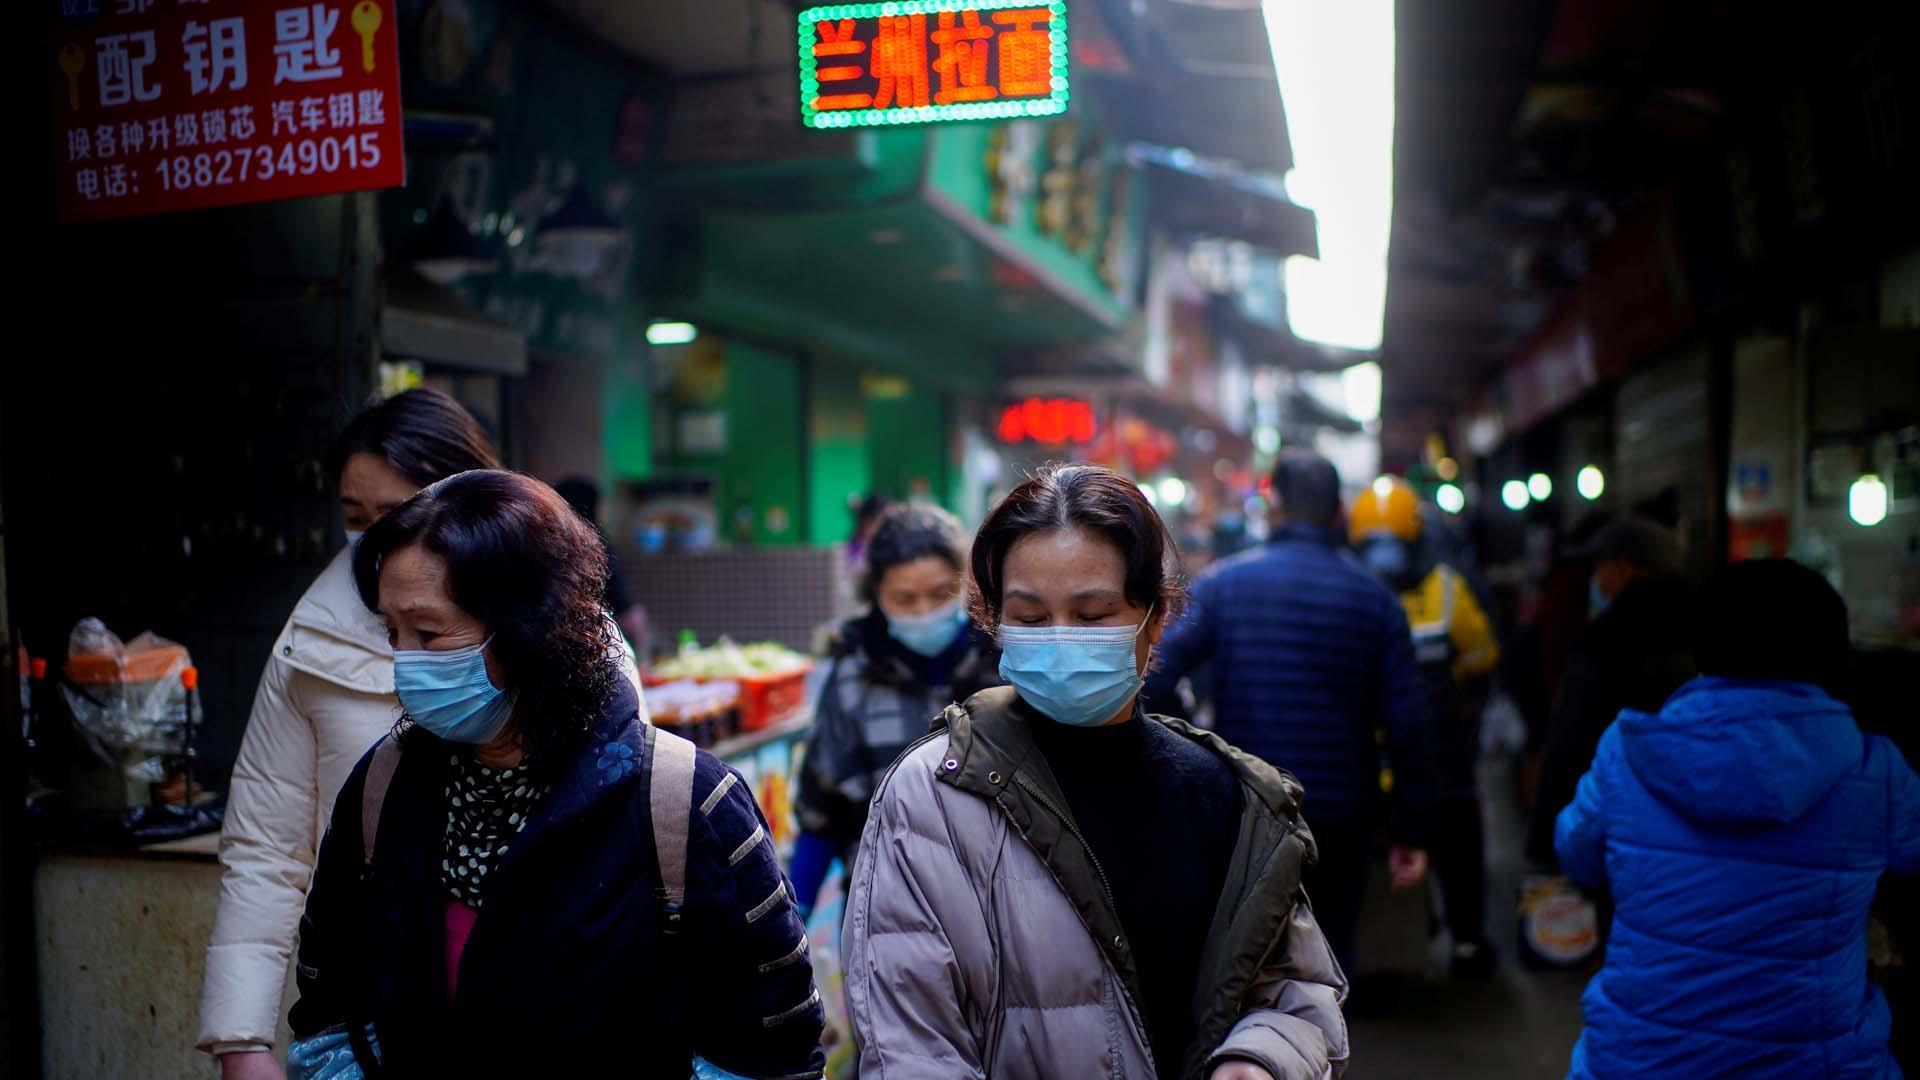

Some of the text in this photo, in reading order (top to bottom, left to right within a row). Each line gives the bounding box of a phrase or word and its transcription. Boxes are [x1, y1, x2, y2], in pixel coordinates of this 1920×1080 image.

[96, 3, 343, 106] 配钥匙
[811, 8, 1051, 109] 兰州拉面
[67, 90, 385, 161] 换各种升级锁芯 汽车钥匙
[155, 133, 381, 191] 18827349015
